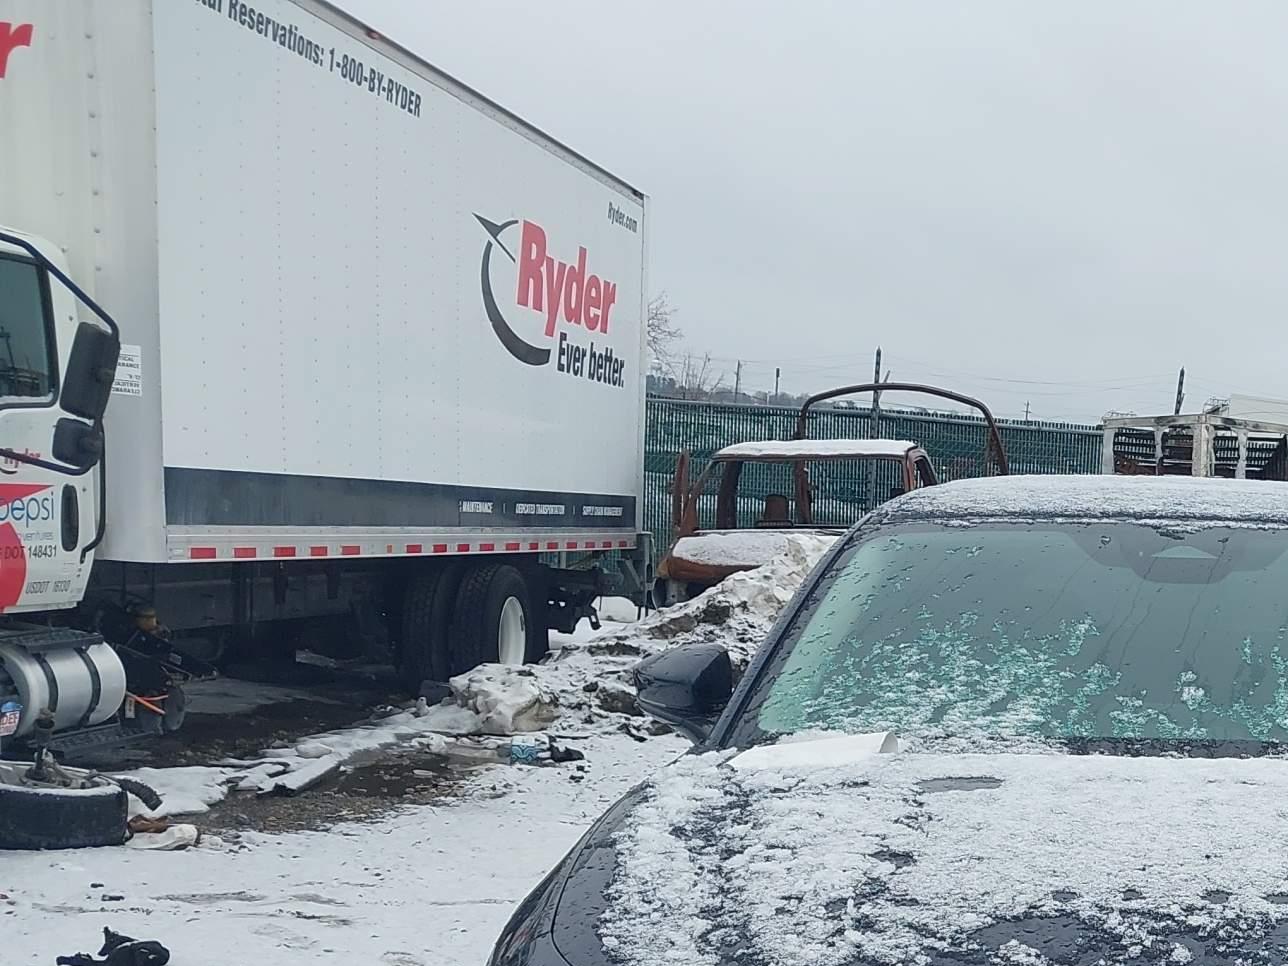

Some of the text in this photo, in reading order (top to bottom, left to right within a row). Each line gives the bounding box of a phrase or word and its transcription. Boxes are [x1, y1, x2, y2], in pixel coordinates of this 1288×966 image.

[228, 0, 422, 118] Reservations: 1-800-BY-RYDER
[608, 201, 637, 233] Ryder.com
[517, 219, 617, 337] Ryder
[557, 332, 625, 388] Ever better.
[28, 545, 57, 559] 148431
